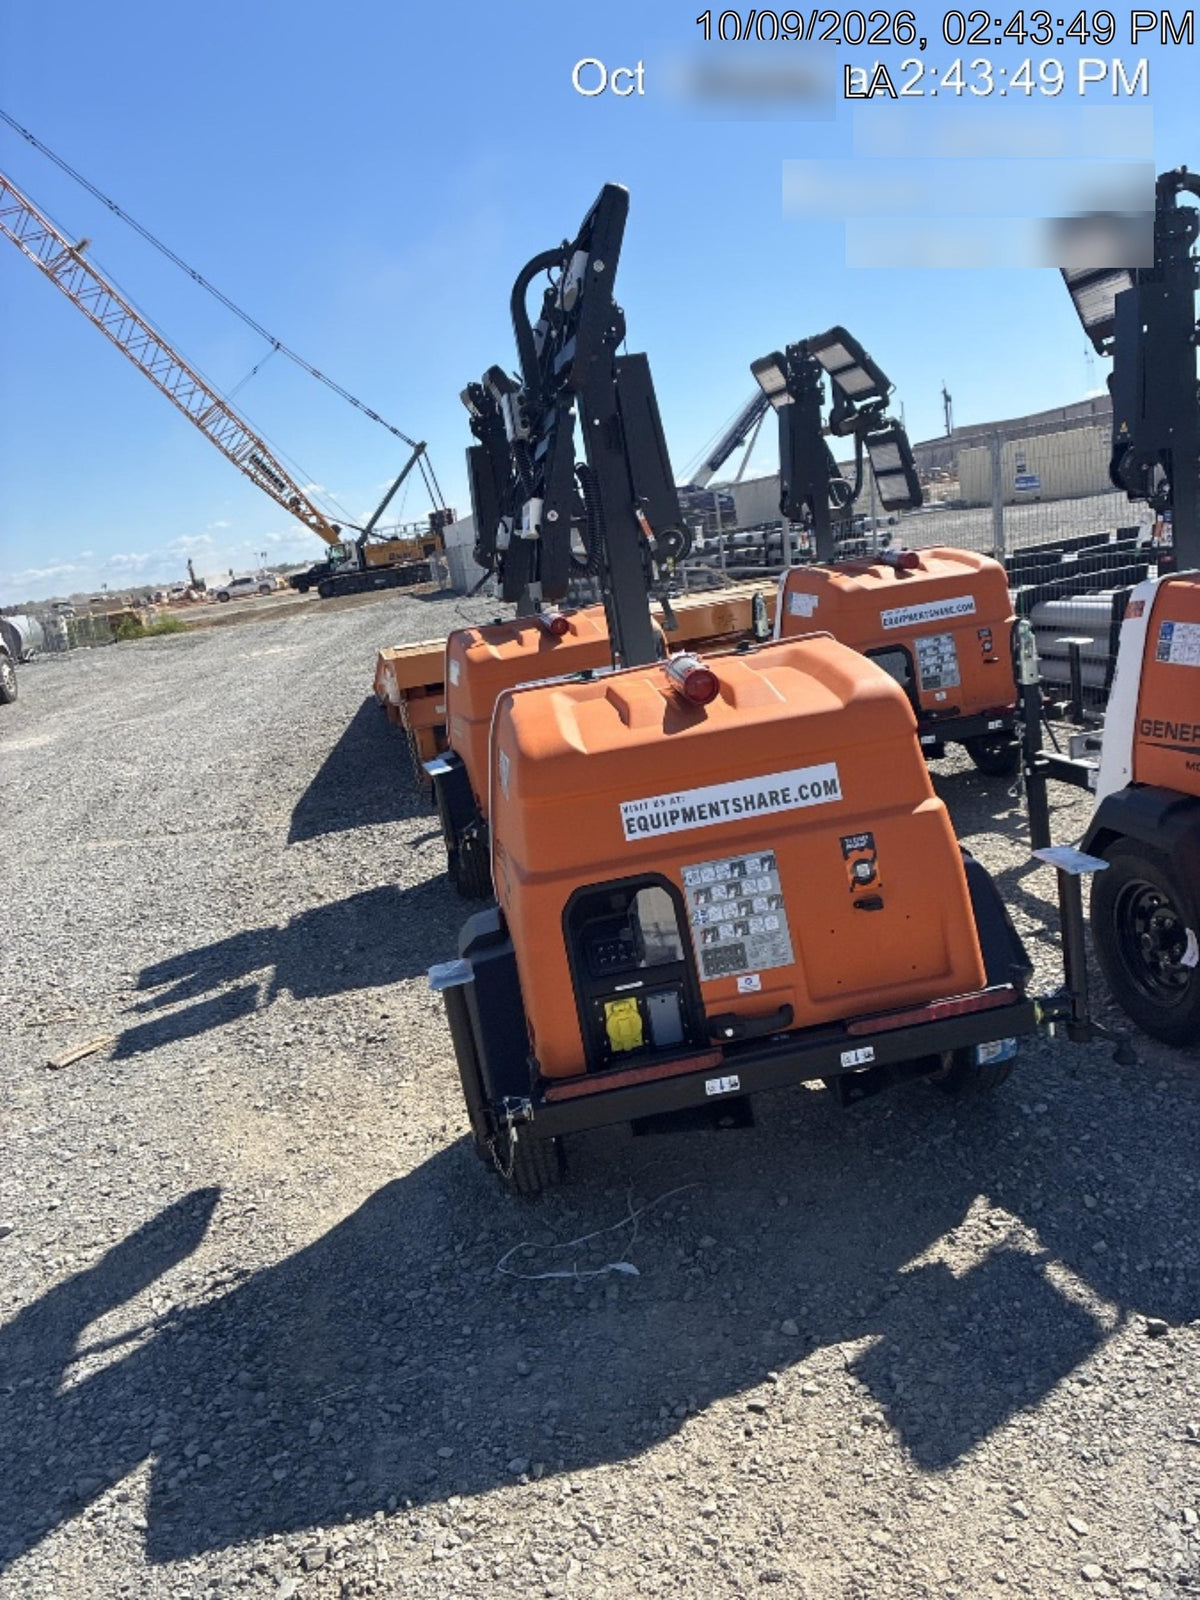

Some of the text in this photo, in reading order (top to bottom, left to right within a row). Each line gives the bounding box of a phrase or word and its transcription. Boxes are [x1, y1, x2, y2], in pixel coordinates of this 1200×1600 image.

[622, 801, 649, 814] VISIT
[653, 799, 666, 808] US
[625, 778, 839, 835] EQUIPMENTSHARE.COM
